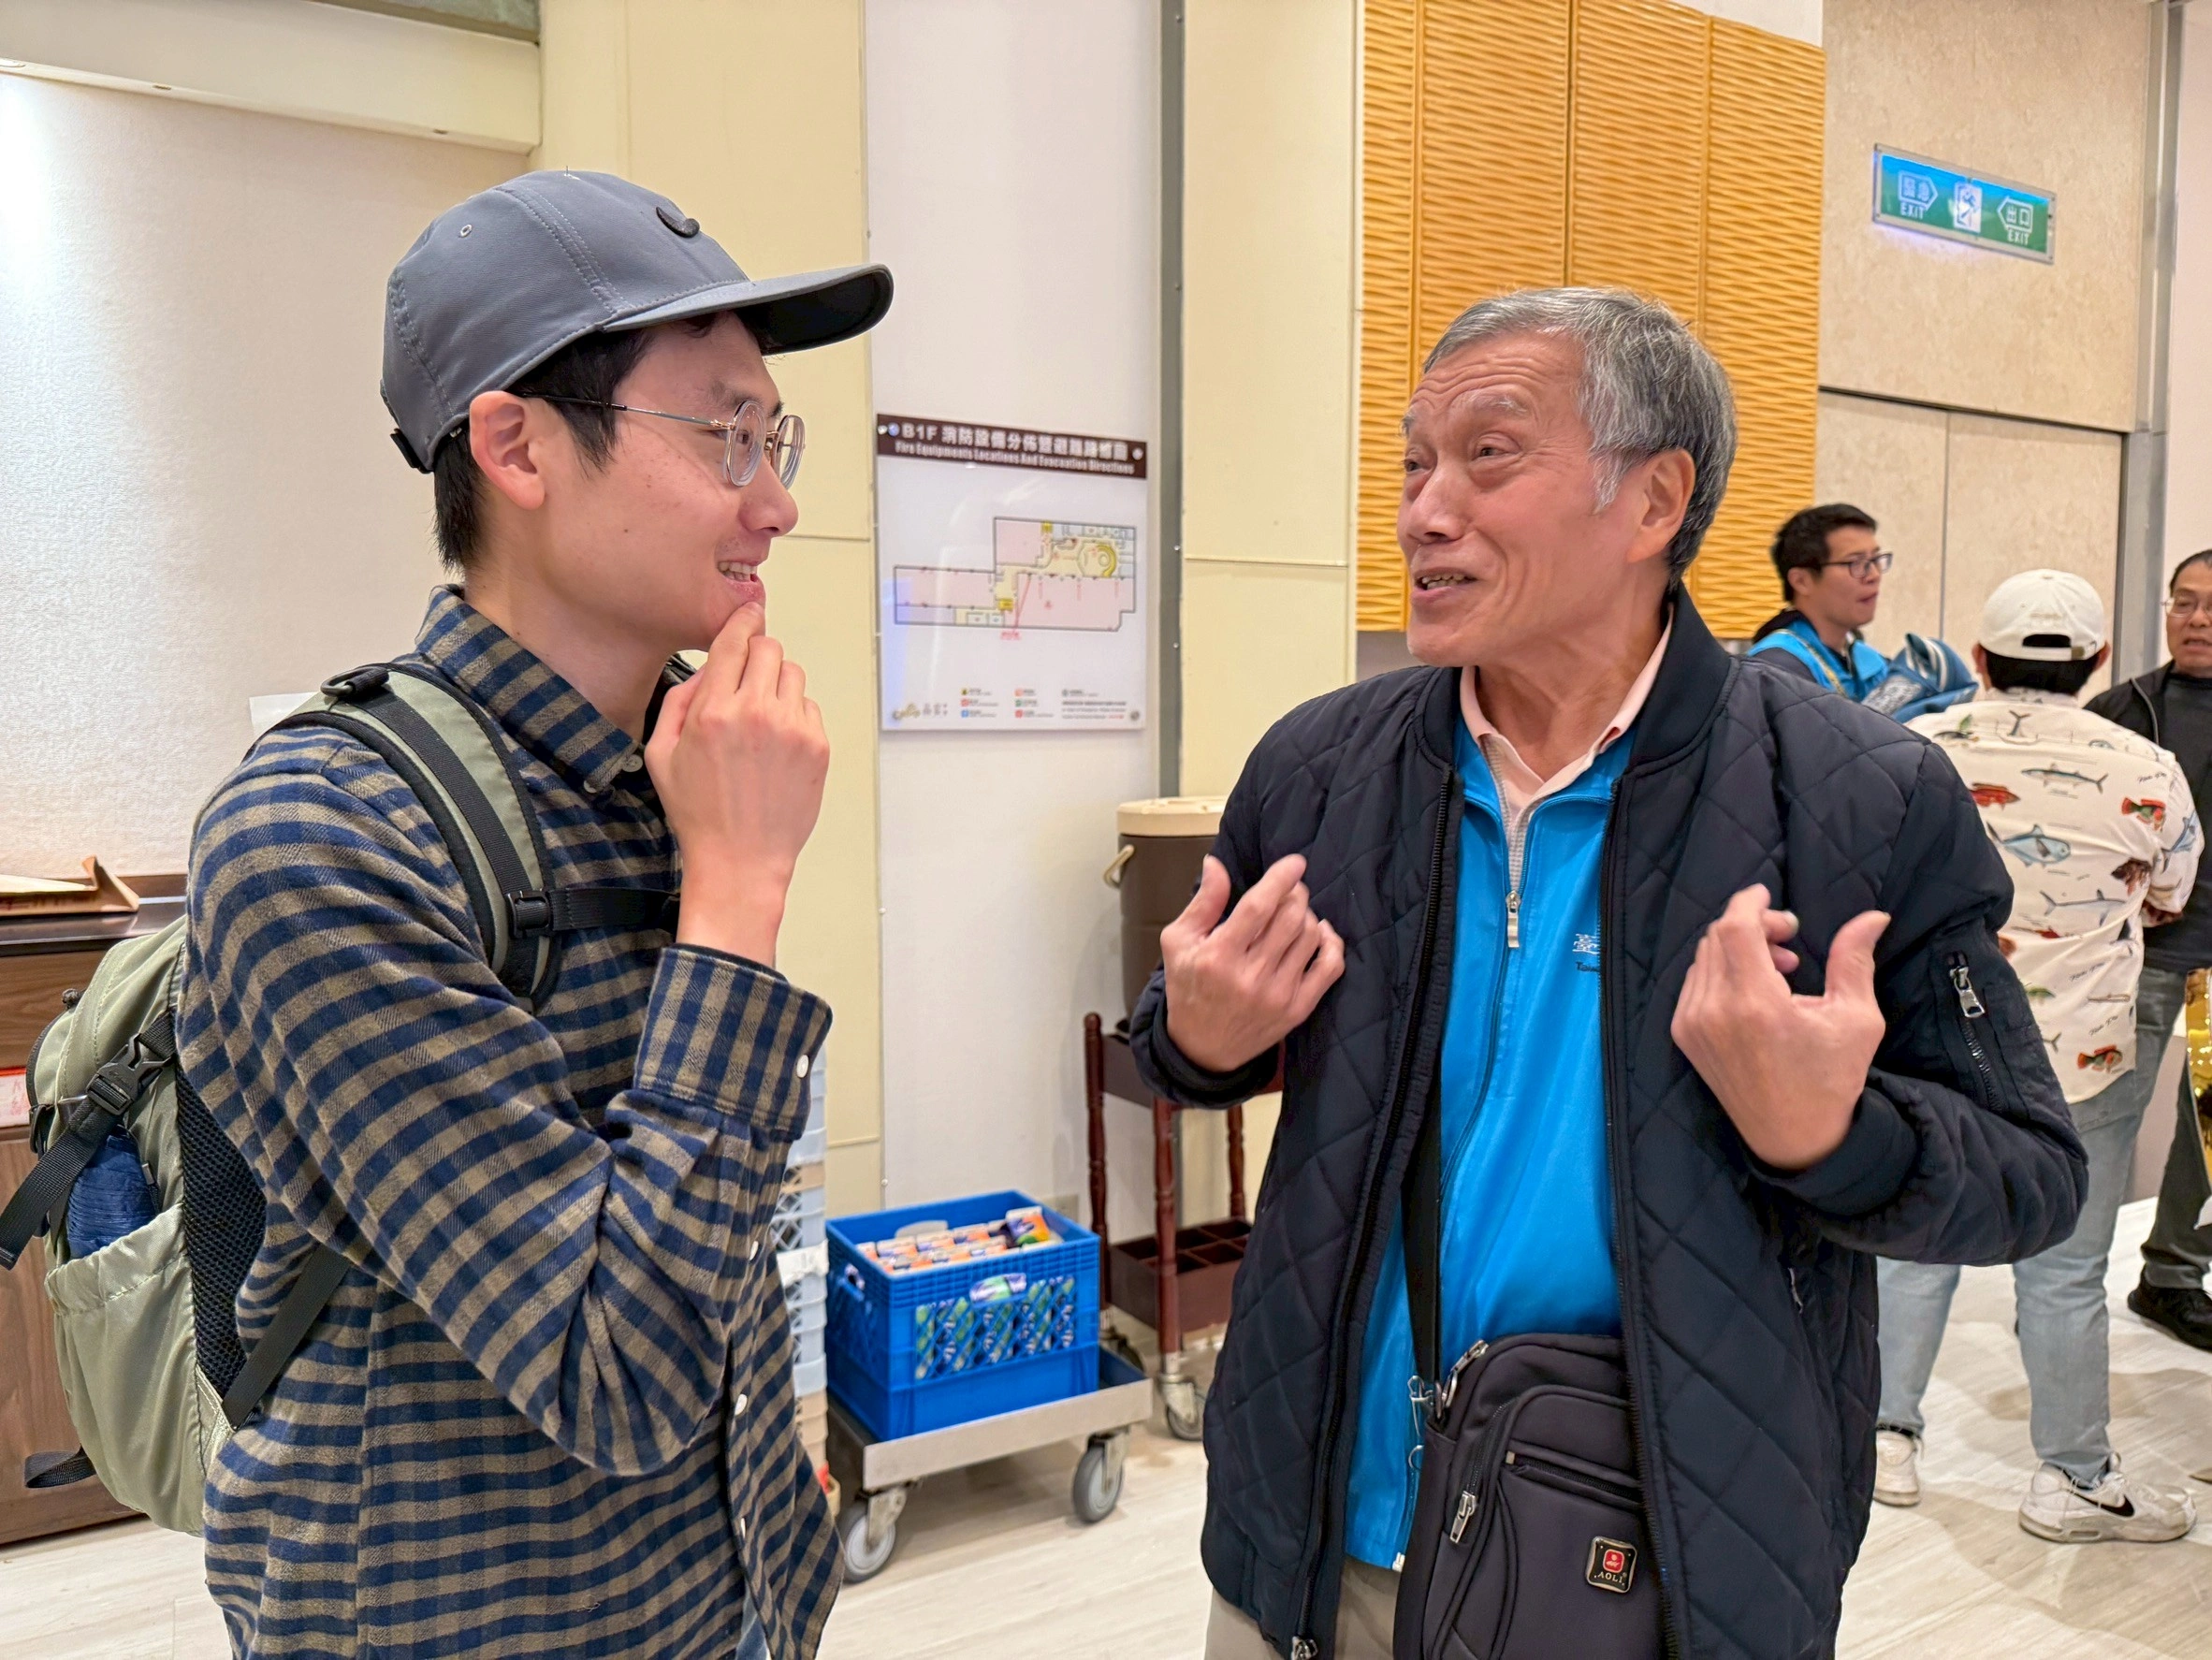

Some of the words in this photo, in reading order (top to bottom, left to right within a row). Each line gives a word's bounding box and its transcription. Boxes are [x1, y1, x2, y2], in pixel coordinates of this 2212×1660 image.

[1900, 201, 1924, 220] EXIT
[2006, 205, 2030, 226] 出口
[2007, 228, 2029, 246] EXIT
[902, 422, 938, 441] B1F
[895, 440, 915, 454] Fire
[1597, 1571, 1623, 1583] AOLI
